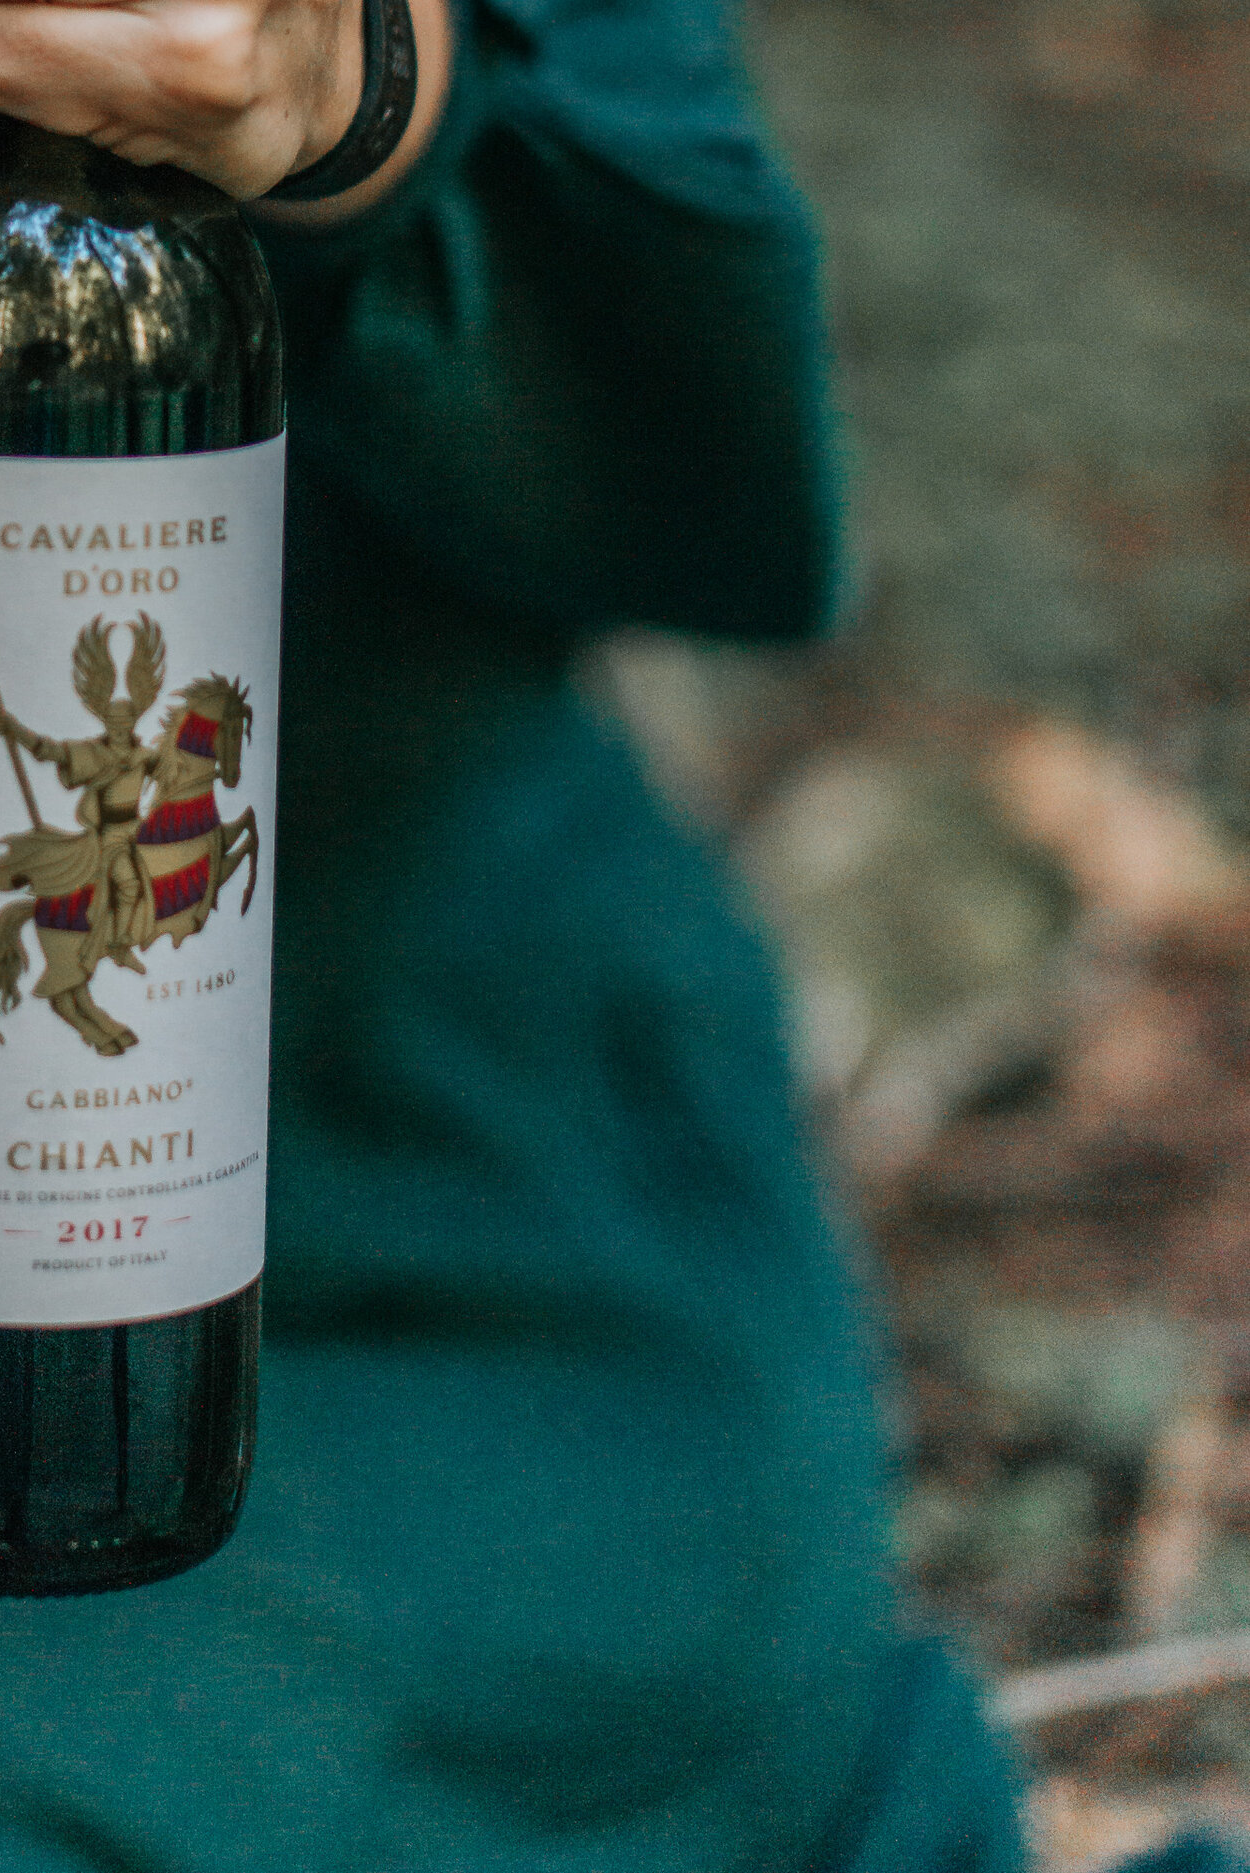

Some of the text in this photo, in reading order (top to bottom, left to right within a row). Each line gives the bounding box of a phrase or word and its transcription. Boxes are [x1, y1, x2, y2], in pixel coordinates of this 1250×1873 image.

[62, 564, 180, 596] D'ORO
[146, 968, 236, 1000] EST 1480
[6, 1128, 194, 1171] CHIANTI
[57, 1214, 149, 1244] 2017
[31, 1257, 103, 1272] PRODUCT
